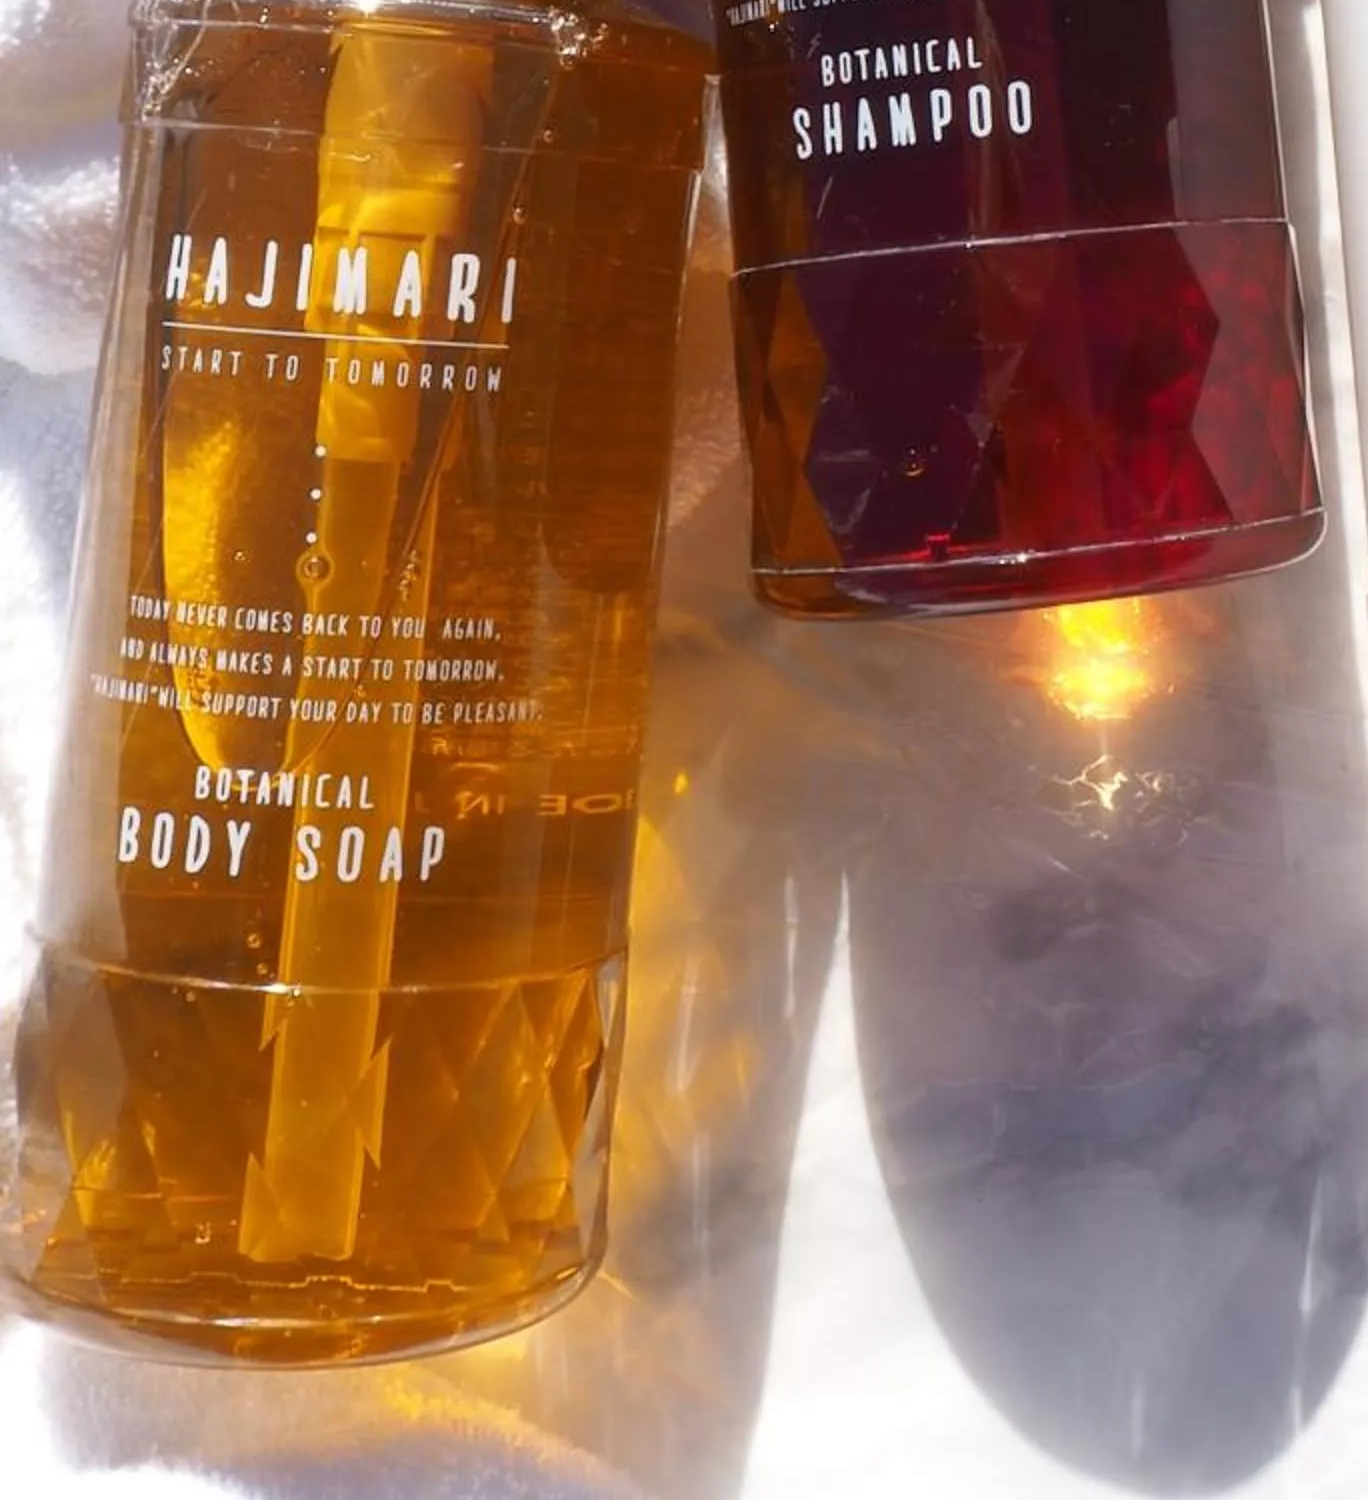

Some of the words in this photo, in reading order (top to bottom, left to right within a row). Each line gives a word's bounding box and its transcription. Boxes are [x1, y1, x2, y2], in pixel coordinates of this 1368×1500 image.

[821, 35, 982, 88] BOTANICAL
[793, 80, 1033, 161] SHAMPOO
[165, 235, 517, 323] HAJIMARI
[161, 345, 241, 375] START
[265, 353, 298, 381] TO
[326, 357, 502, 392] TOMORROW
[130, 595, 171, 621] TODAY
[176, 599, 227, 629] NEVER
[235, 608, 293, 634] COMES
[302, 613, 350, 637] BACK
[359, 615, 382, 638] TO
[392, 617, 425, 640] YOU
[120, 637, 144, 660] AND
[150, 642, 208, 668] ALWAYS
[215, 650, 273, 675] MAKES
[282, 655, 292, 676] A
[303, 656, 361, 680] START
[371, 659, 393, 681] TO
[404, 659, 504, 681] TOMORROW.
[201, 691, 282, 720] SUPPORT
[290, 699, 338, 722] YOUR
[346, 700, 382, 723] DAY
[392, 702, 413, 723] TO
[421, 702, 445, 725] BE
[452, 699, 543, 724] PLEASANT.
[194, 765, 375, 811] BOTANICAL
[118, 807, 251, 877] BODY
[295, 824, 446, 883] SOAP
